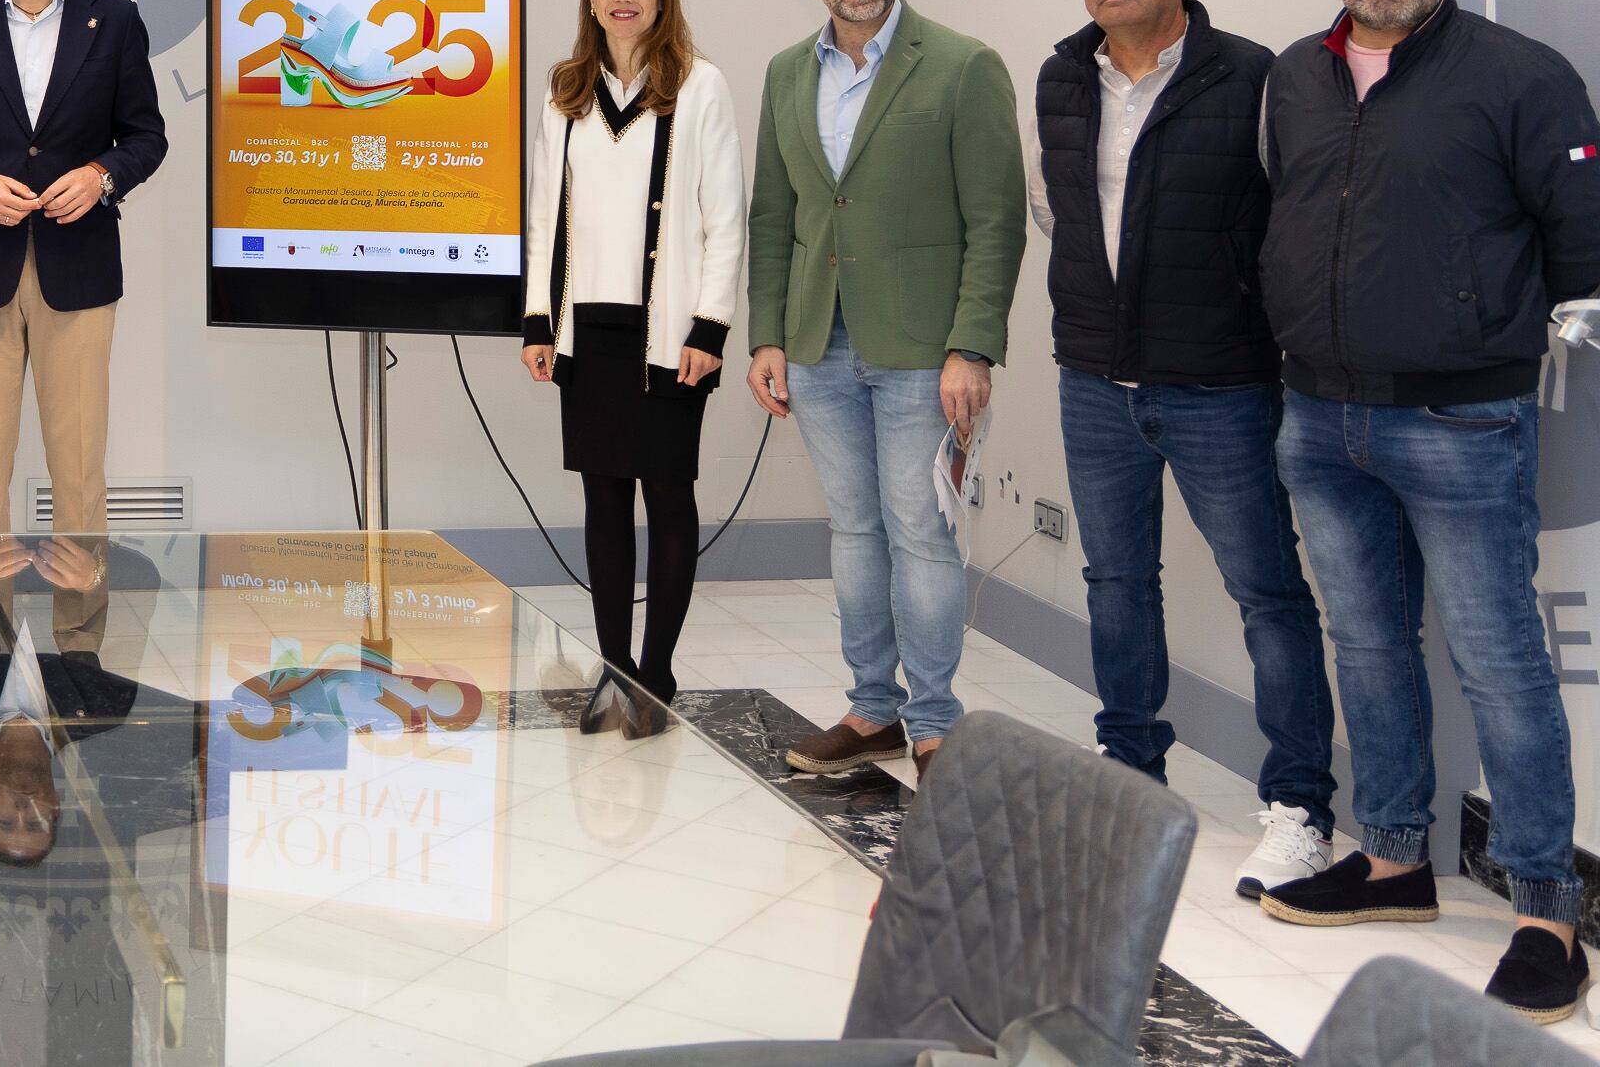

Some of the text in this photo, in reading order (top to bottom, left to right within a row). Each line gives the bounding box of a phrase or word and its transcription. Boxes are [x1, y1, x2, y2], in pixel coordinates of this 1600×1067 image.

[246, 138, 301, 146] COMERCIAL
[395, 140, 489, 149] PROFESIONAL B2B
[228, 149, 272, 166] Mayo
[274, 150, 297, 166] 30,
[317, 153, 330, 167] y
[333, 151, 340, 164] 1
[401, 152, 484, 169] 2 y 3 Junio
[245, 186, 282, 195] Claustro
[284, 186, 338, 196] Monumental
[340, 188, 373, 196] Jesuita.
[376, 188, 406, 199] Iglesia
[408, 189, 419, 197] de
[421, 189, 430, 198] la
[282, 196, 445, 208] Caravaca de la Cruz, Murcia, España.
